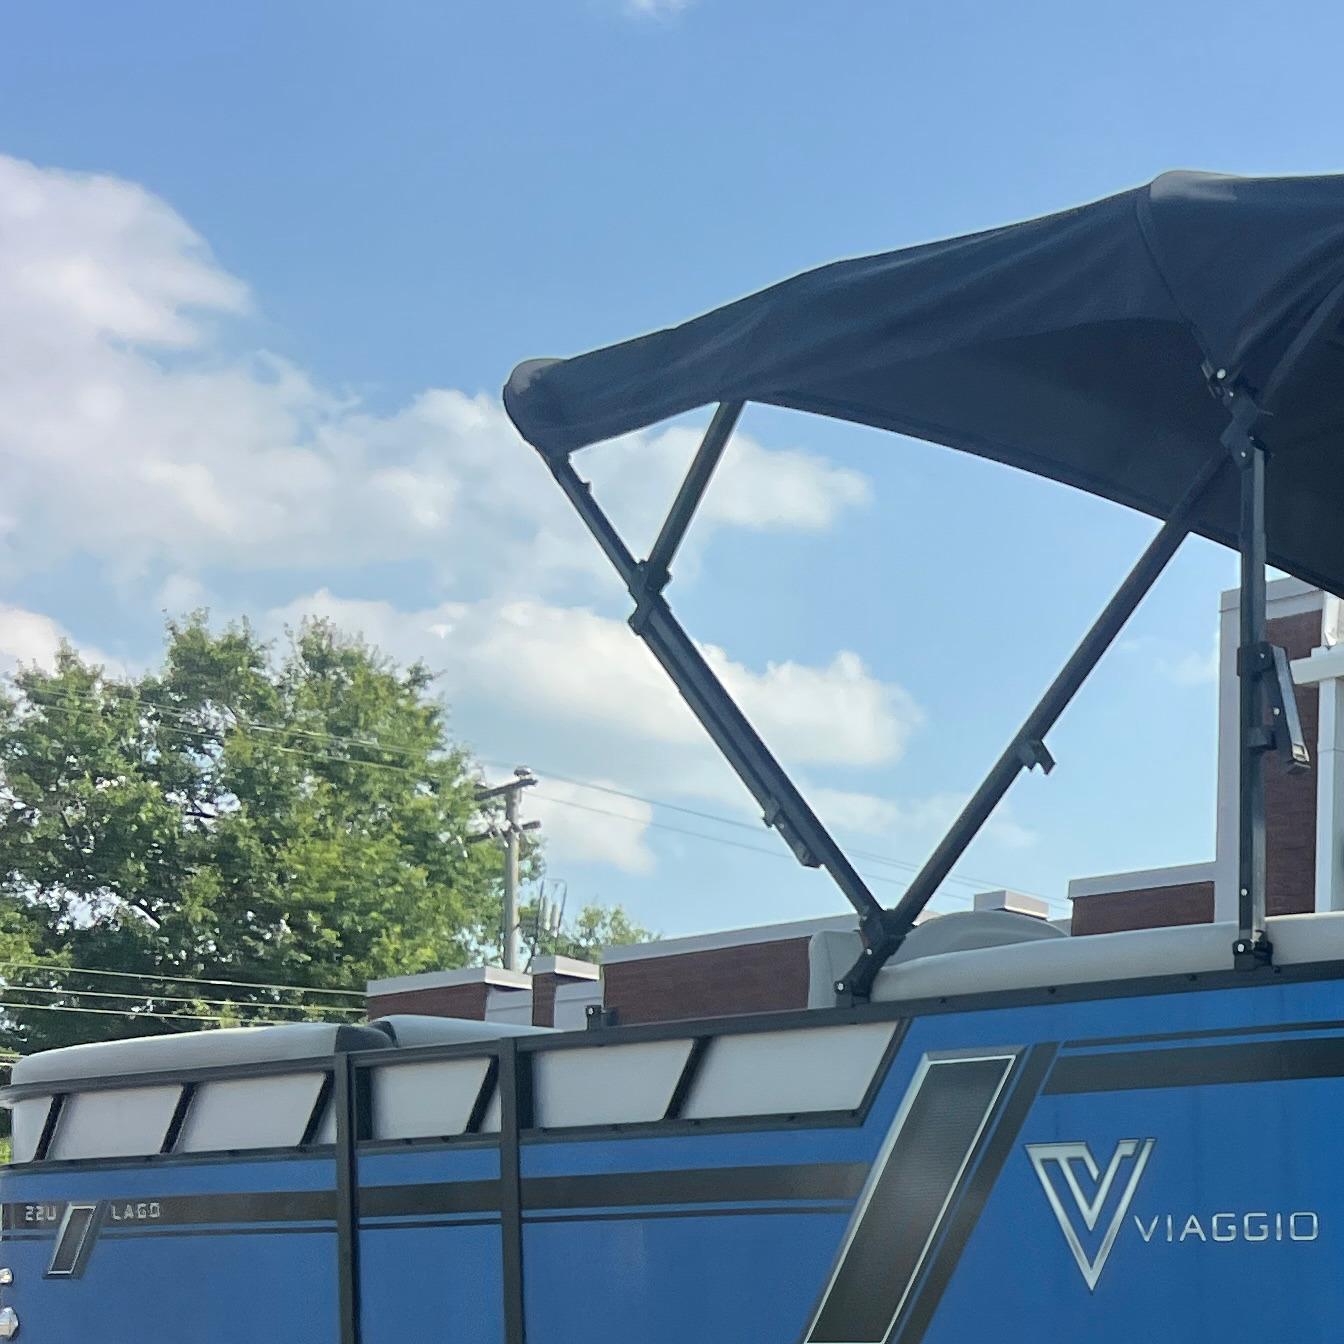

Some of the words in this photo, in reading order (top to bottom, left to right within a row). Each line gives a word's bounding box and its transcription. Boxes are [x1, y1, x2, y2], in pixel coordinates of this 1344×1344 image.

[24, 1205, 57, 1221] 22U
[111, 1202, 161, 1221] LAGO
[1134, 1211, 1319, 1242] VIAGGIO
